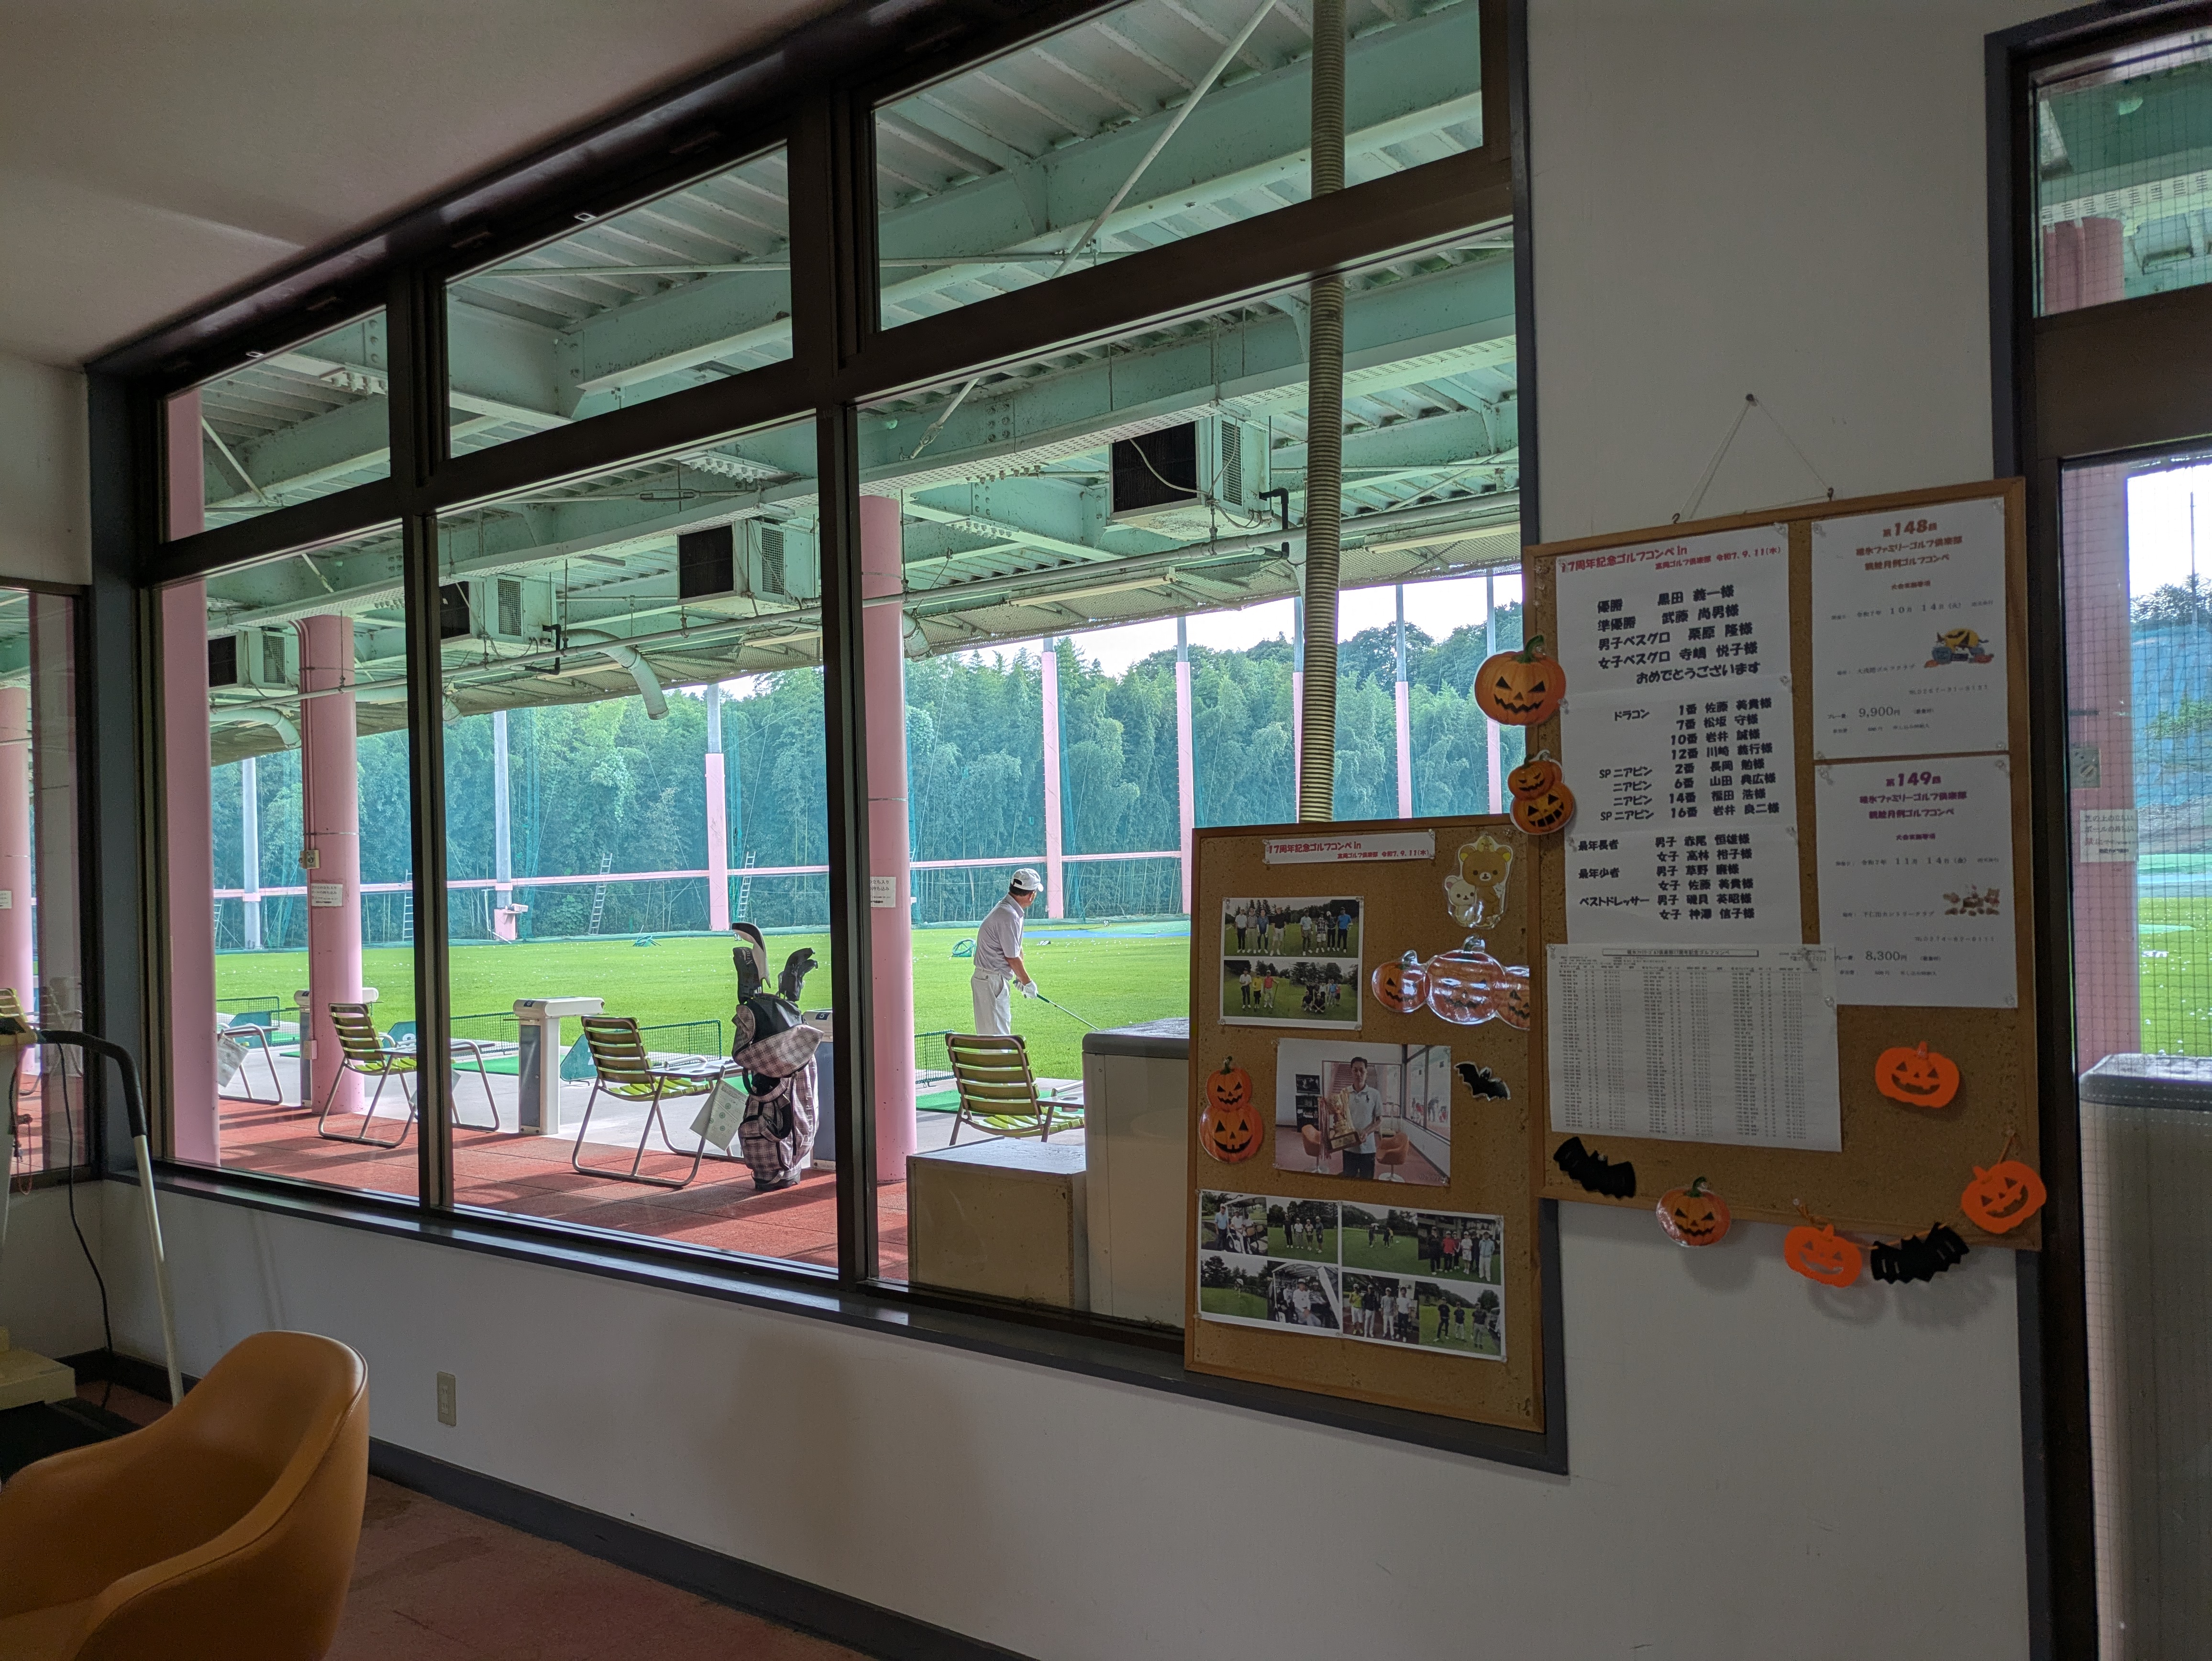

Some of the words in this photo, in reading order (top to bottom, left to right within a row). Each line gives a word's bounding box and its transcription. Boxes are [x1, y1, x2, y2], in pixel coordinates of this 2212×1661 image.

[1677, 545, 1687, 555] in
[1597, 598, 1623, 614] 優勝
[1657, 591, 1684, 606] 黒田
[1597, 616, 1636, 632] 準優勝
[1661, 609, 1689, 625] 武藤
[1598, 631, 1670, 651] 男子ベスグロ
[1598, 651, 1670, 670] 女子ベスグロ
[1636, 661, 1761, 685] おめでとうございます
[1615, 709, 1650, 721] ドラコン
[1679, 703, 1697, 716] 1番
[1705, 701, 1728, 714] 佐藤
[1676, 718, 1696, 731] 7番
[1671, 733, 1698, 745] 10番
[1705, 731, 1729, 743] 岩井
[1671, 748, 1699, 760] 12番
[1599, 769, 1611, 779] SP
[1613, 766, 1653, 778] ニアピン
[1675, 763, 1695, 775] 2番
[1710, 760, 1734, 772] 長岡
[1613, 781, 1652, 792] ニアピン
[1674, 777, 1694, 789] 6番
[1710, 775, 1733, 786] 山田
[1613, 795, 1652, 806] ニアピン
[1669, 792, 1696, 804] 14番
[1600, 811, 1613, 821] SP
[1615, 809, 1654, 820] ニアピン
[1671, 806, 1698, 819] 16番
[1713, 804, 1736, 816] 岩井
[1267, 840, 1353, 854] 17周年記念ゴルフコンペ
[1353, 841, 1361, 849] in
[1578, 839, 1619, 851] 最年長者
[1655, 836, 1677, 848] 男子
[1657, 851, 1679, 863] 女子
[1578, 867, 1620, 879] 最年少者
[1656, 865, 1678, 877] 男子
[1658, 880, 1681, 891] 女子
[1579, 896, 1650, 907] ベストドレッサー
[1657, 894, 1679, 906] 男子
[1659, 908, 1681, 920] 女子
